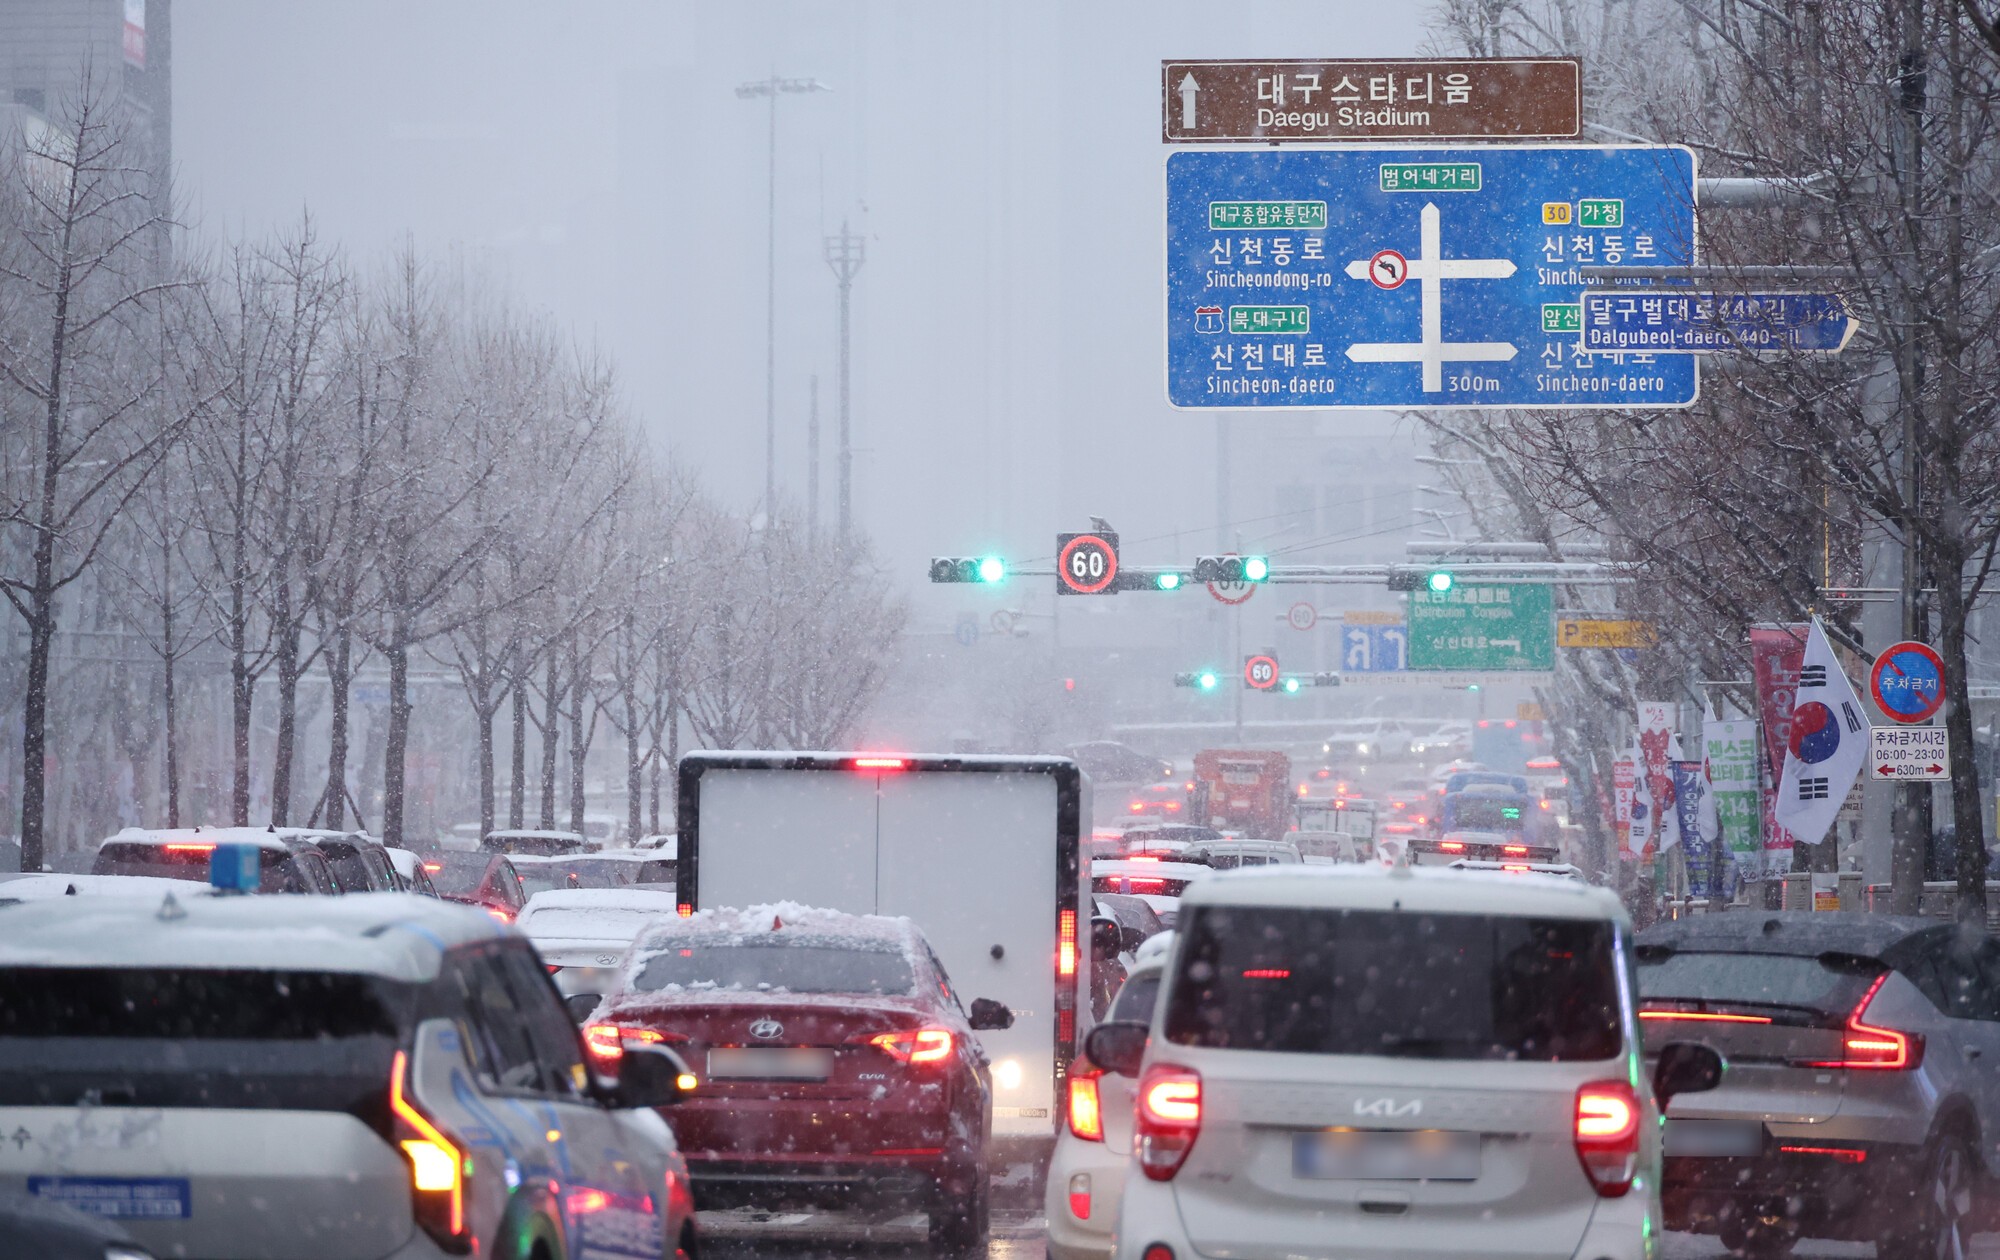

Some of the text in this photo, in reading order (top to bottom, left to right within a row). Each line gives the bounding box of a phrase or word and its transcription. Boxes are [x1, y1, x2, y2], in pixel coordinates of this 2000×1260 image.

[1257, 73, 1473, 105] 대구스타디움
[1258, 107, 1430, 131] Daegu Stadium
[1384, 168, 1476, 187] 범어네거리
[1214, 206, 1324, 225] 대구종합유통단지
[1547, 206, 1567, 221] 30
[1584, 204, 1618, 223] 가창
[1209, 237, 1326, 266] 신천동로
[1542, 235, 1657, 264] 신천동로
[1206, 270, 1332, 291] Sincheondong-ro
[1206, 315, 1212, 330] 1
[1233, 311, 1306, 330] 북대구IC
[1544, 309, 1580, 328] 앞산
[1740, 329, 1800, 345] 440-il
[1207, 376, 1335, 394] Sincheon-daero
[1449, 376, 1500, 393] 300m
[1537, 374, 1664, 392] Sincheon-daero
[1072, 551, 1102, 577] 60
[1565, 624, 1578, 641] P
[1252, 664, 1272, 680] 60
[1883, 677, 1937, 690] 주차금지
[1875, 731, 1946, 746] 주차금지시간
[1876, 749, 1945, 761] 06:00~23:00
[1897, 764, 1925, 776] 630m
